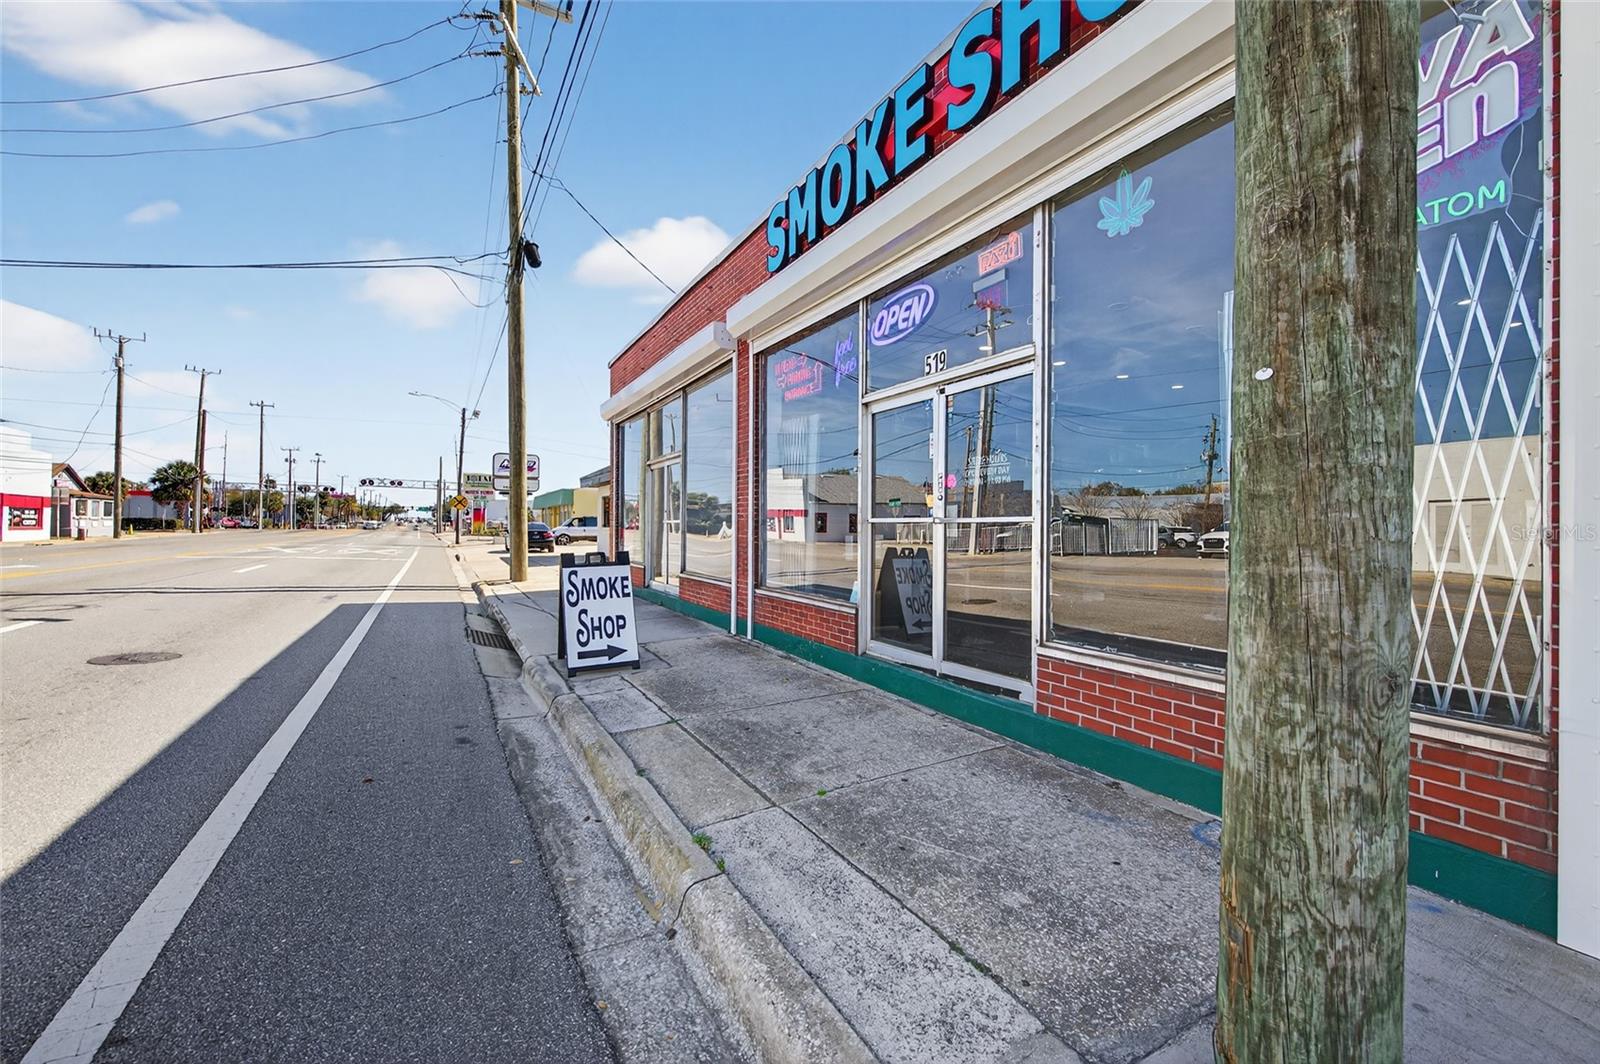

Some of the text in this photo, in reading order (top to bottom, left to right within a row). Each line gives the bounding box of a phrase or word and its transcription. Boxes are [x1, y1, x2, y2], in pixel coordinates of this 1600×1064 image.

[766, 0, 1130, 274] SMOKE SH
[873, 292, 926, 338] OPEN
[925, 353, 946, 373] 519
[566, 570, 631, 608] SMOKE
[576, 609, 626, 647] SHOP
